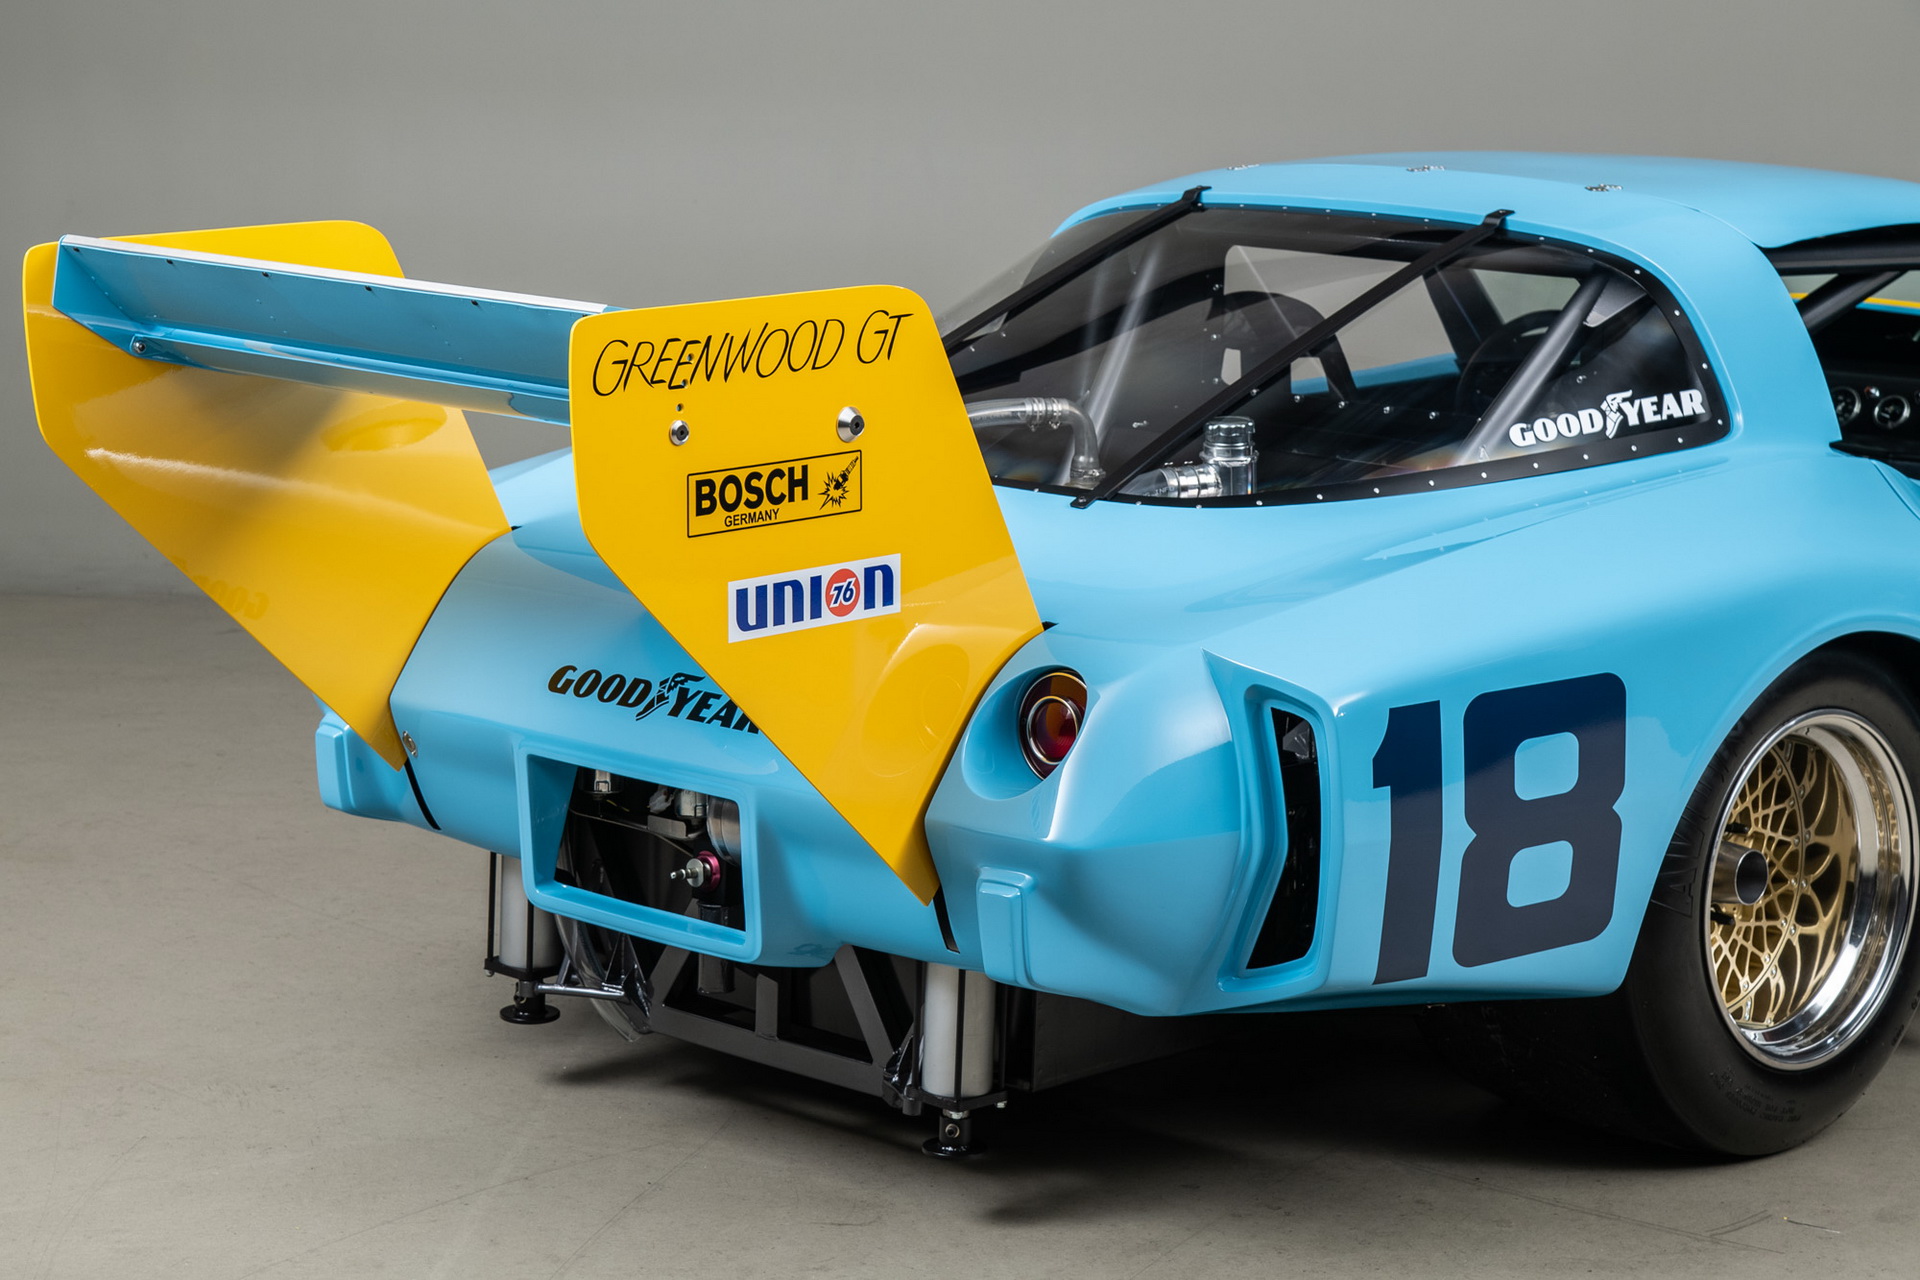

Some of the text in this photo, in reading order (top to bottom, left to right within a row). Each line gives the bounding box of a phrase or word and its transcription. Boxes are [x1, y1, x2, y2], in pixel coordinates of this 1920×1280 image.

[592, 309, 914, 397] GREENWOOD GT
[695, 463, 809, 517] BOSCH
[724, 508, 780, 528] GERMANY
[829, 577, 857, 608] 76
[1372, 671, 1627, 986] 18
